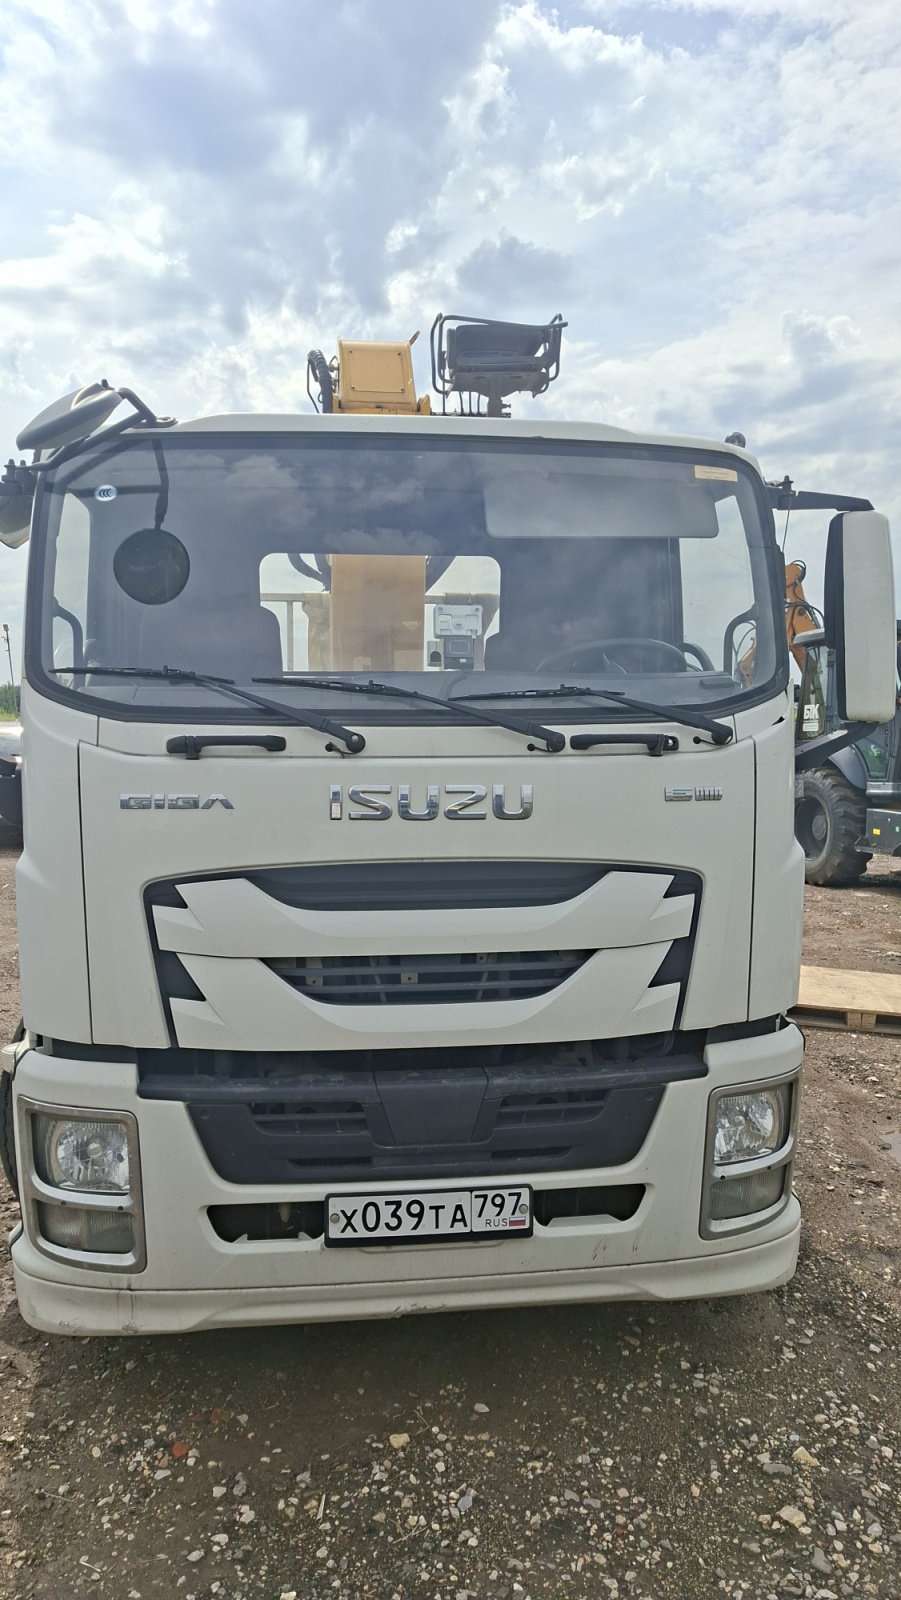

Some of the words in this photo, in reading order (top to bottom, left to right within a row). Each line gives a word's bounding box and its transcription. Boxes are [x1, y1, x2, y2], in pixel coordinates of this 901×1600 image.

[119, 793, 235, 810] GIGA
[329, 784, 534, 821] ISUZU
[474, 1191, 522, 1219] 797
[484, 1217, 508, 1228] RUS
